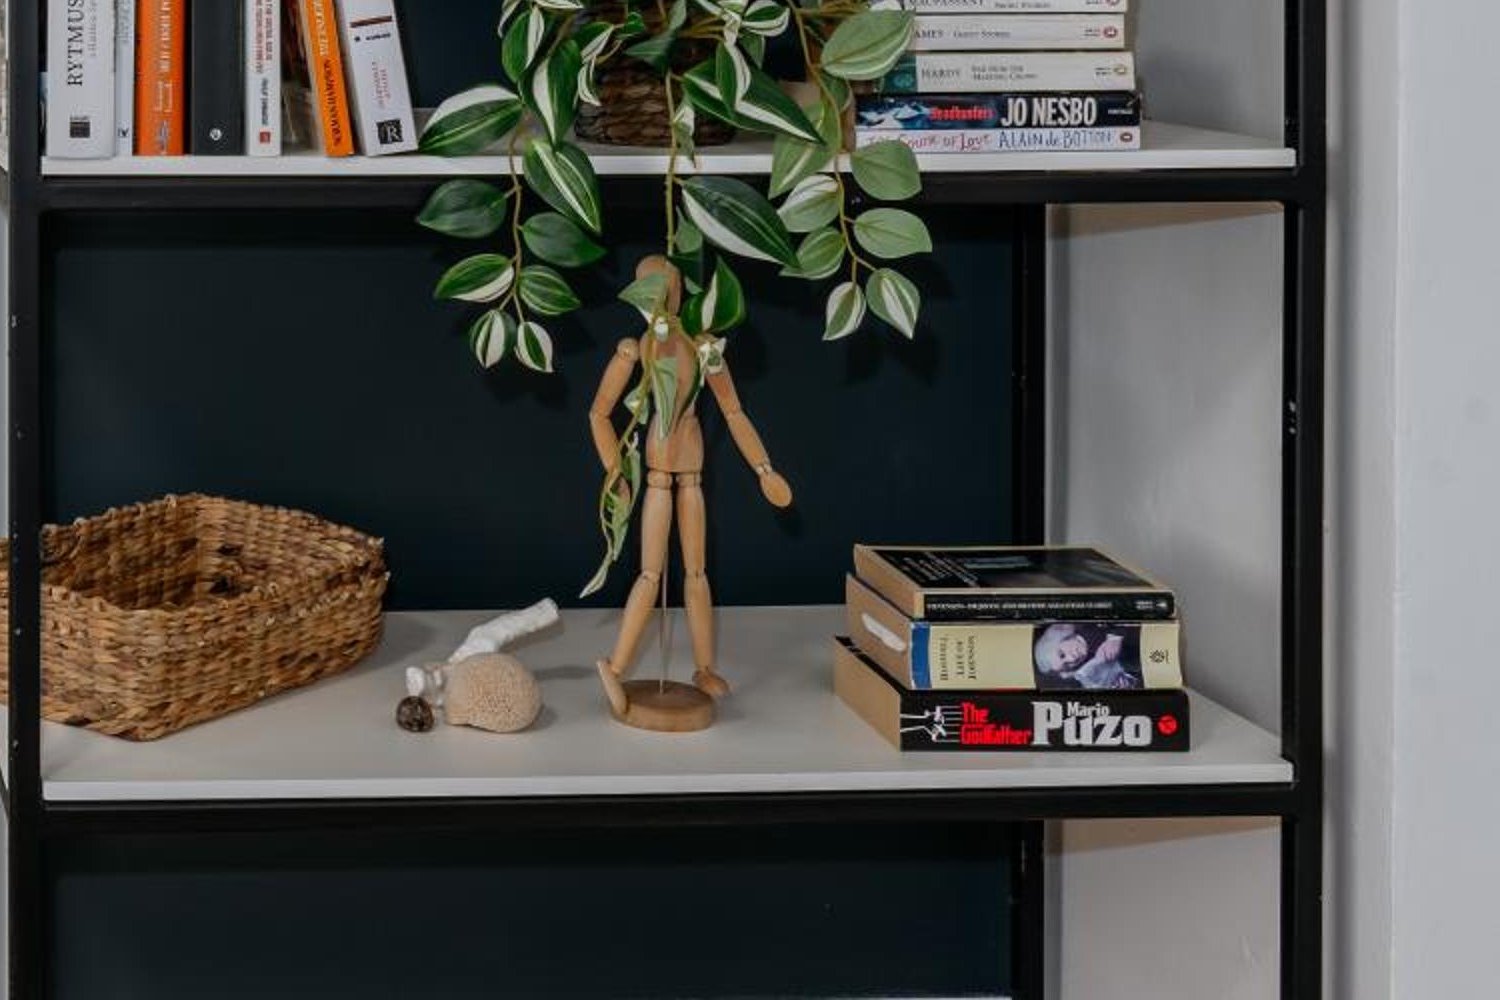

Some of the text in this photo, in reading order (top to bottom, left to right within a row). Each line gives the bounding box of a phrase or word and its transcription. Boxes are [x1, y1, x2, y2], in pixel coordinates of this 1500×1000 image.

[915, 30, 945, 39] AMES
[921, 68, 961, 79] HARDY
[1001, 97, 1097, 127] JO NESBO
[961, 702, 990, 723] The
[1067, 701, 1110, 717] Mario
[960, 722, 1032, 745] Godfather
[1031, 701, 1153, 747] Puzo
